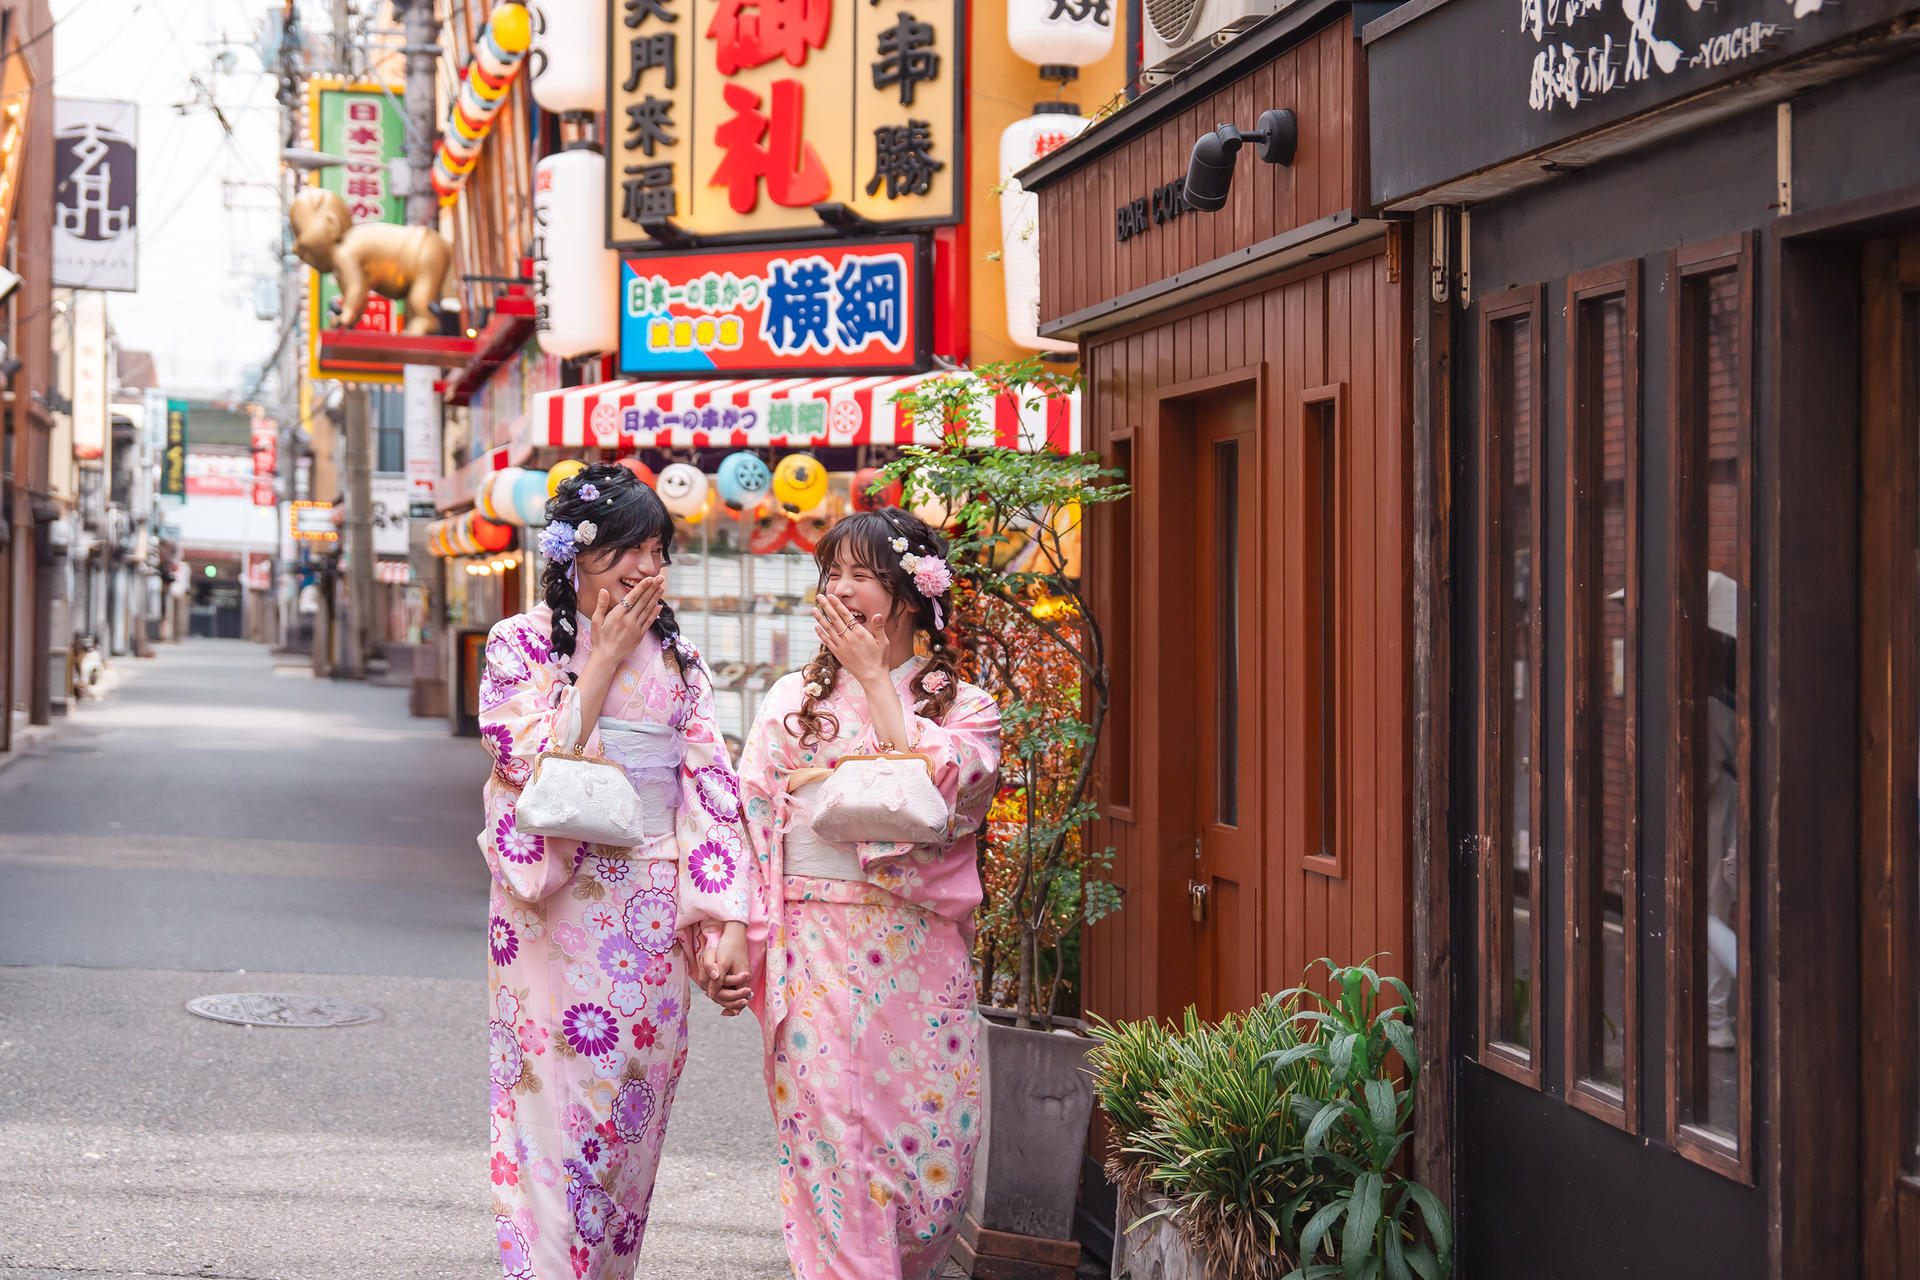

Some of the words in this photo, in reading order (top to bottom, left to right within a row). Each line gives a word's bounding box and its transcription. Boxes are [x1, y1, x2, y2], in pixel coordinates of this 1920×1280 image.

[866, 0, 944, 200] 串勝
[1117, 197, 1149, 242] BAR
[1152, 176, 1194, 226] COR
[631, 279, 760, 313] 日本一の串かつ
[766, 260, 902, 349] 横綱
[624, 406, 758, 433] 日本一の串かつ
[767, 401, 826, 436] 横綱
